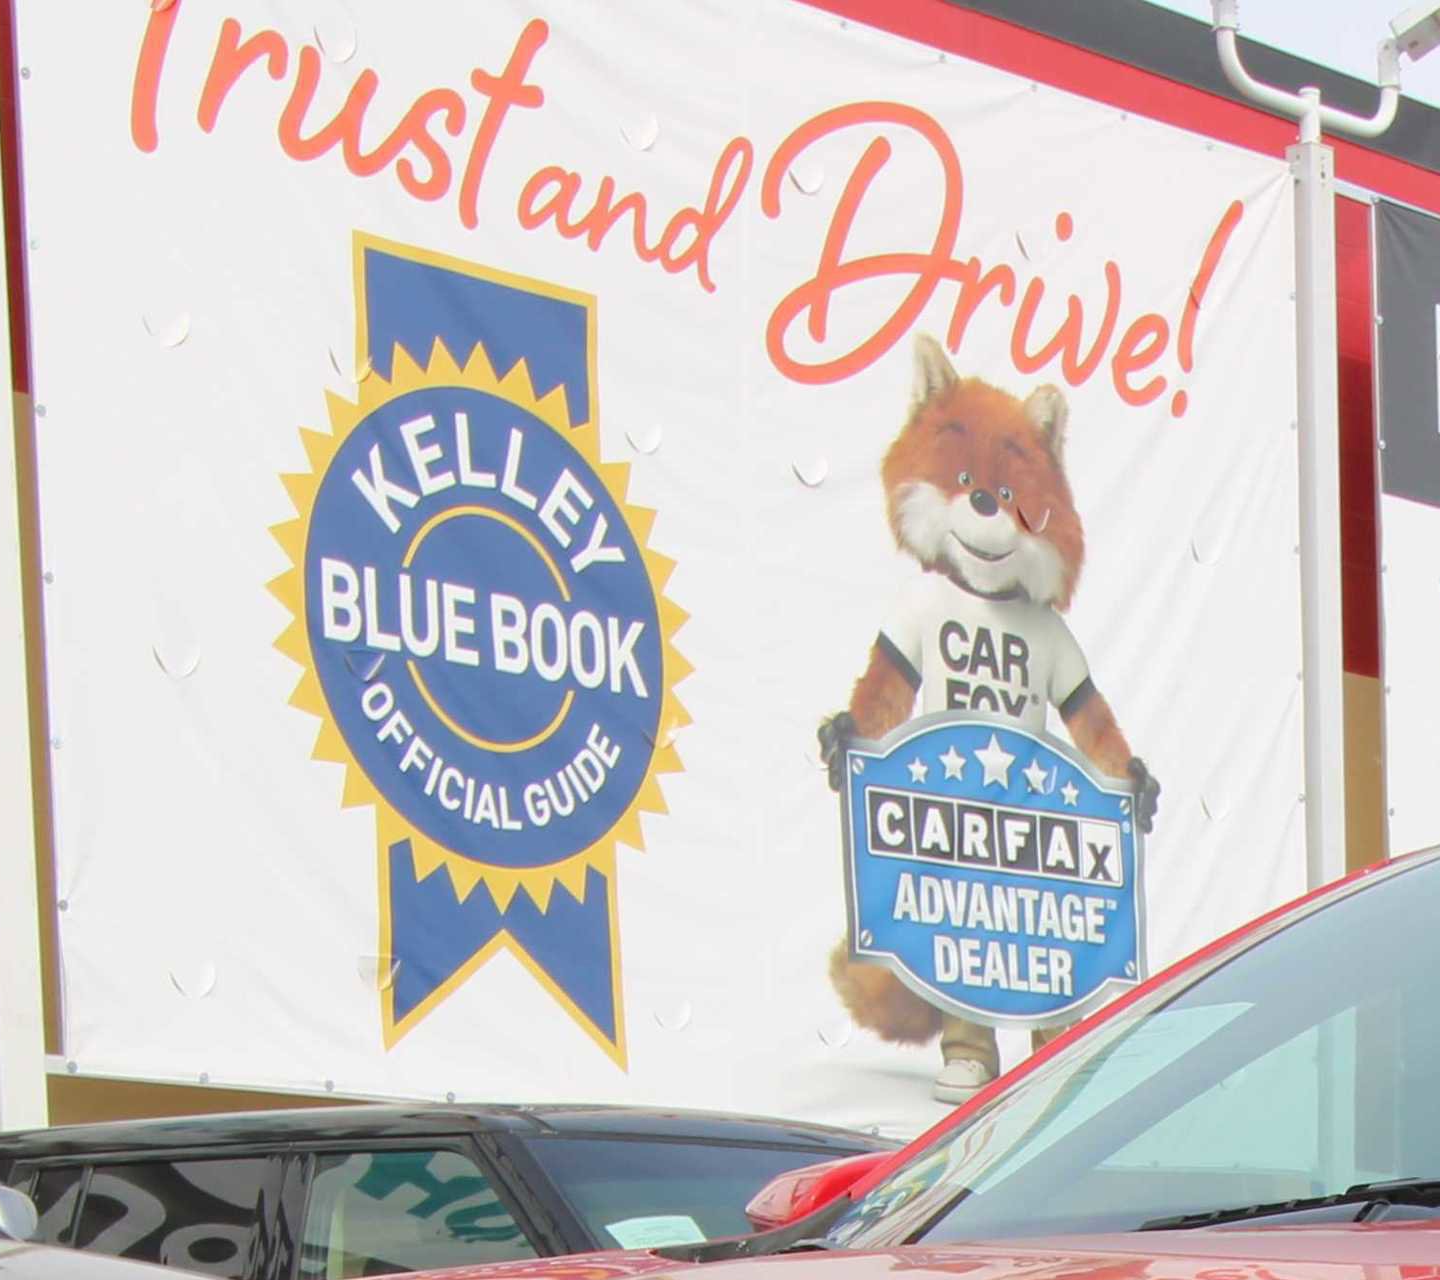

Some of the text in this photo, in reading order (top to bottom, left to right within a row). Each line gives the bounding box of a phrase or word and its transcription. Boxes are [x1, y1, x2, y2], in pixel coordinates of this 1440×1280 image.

[130, 0, 1242, 418] Trust and Drive!
[351, 412, 626, 574] KELLEY
[321, 557, 648, 698] BLUE BOOK
[938, 619, 1030, 688] CAR
[361, 681, 621, 830] OFFICIAL GUIDE
[876, 800, 1115, 882] CARFAX
[933, 935, 1073, 997] DEALER
